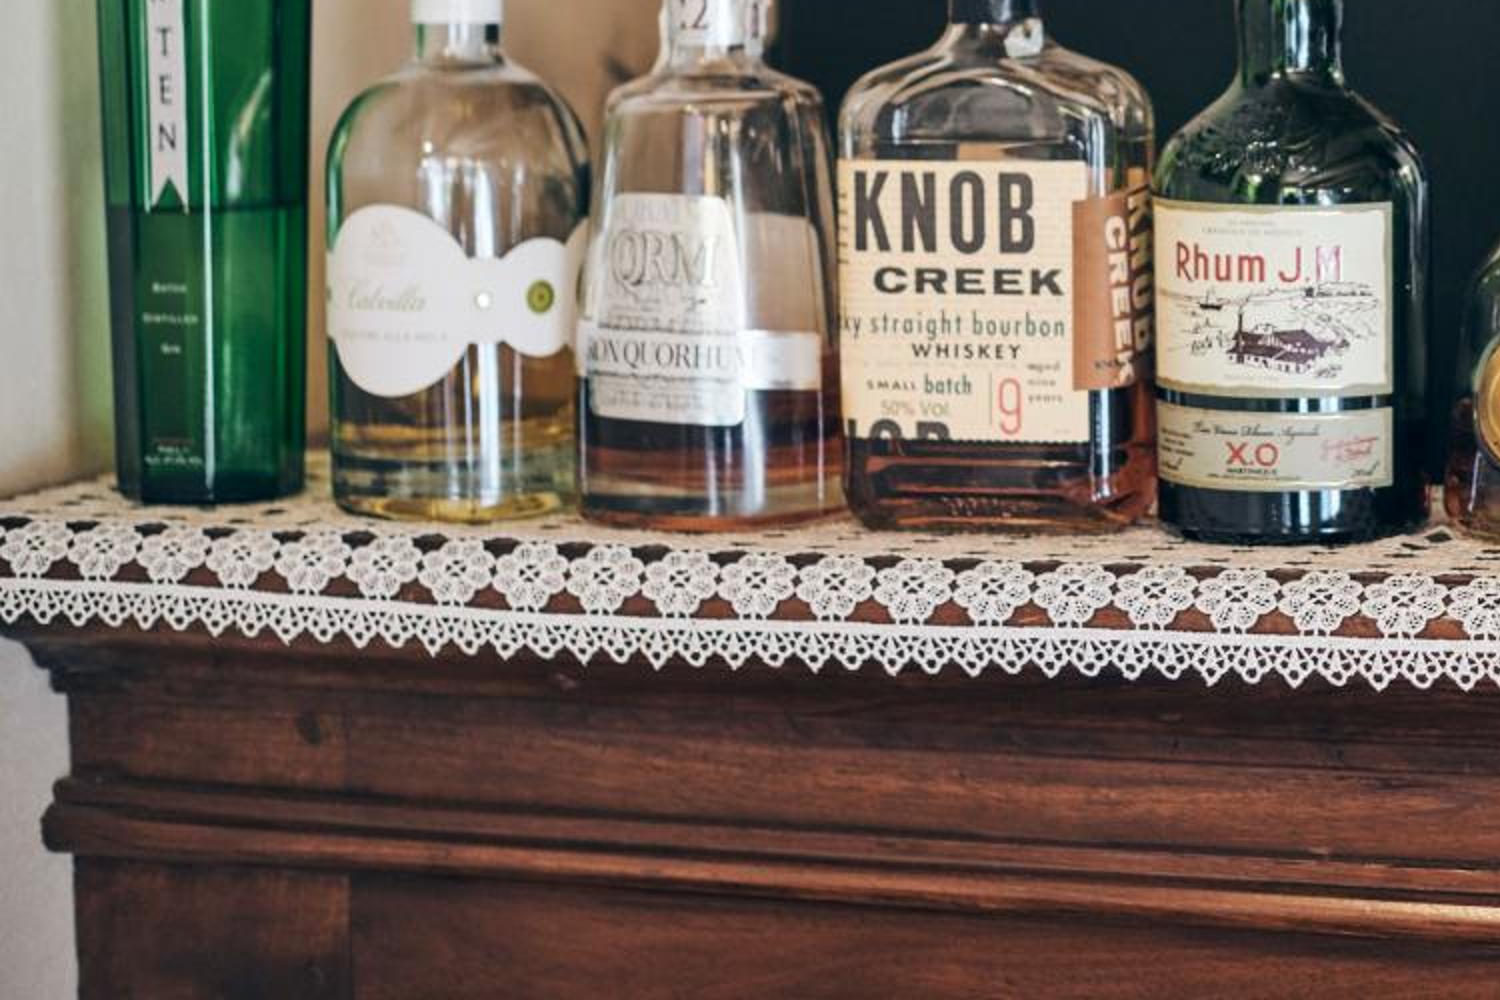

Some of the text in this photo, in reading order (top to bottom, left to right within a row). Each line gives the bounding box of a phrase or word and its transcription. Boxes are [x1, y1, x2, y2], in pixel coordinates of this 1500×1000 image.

[157, 26, 177, 152] TEN
[854, 171, 1035, 254] KNOB
[874, 267, 1064, 295] CREEK
[1176, 241, 1266, 283] Rhum
[1105, 215, 1135, 388] CREEK
[870, 308, 962, 341] straight
[973, 310, 1065, 337] bourbon
[911, 343, 1022, 360] WHISKEY
[867, 373, 1022, 435] SMALL batch 9
[1225, 441, 1279, 467] X.O
